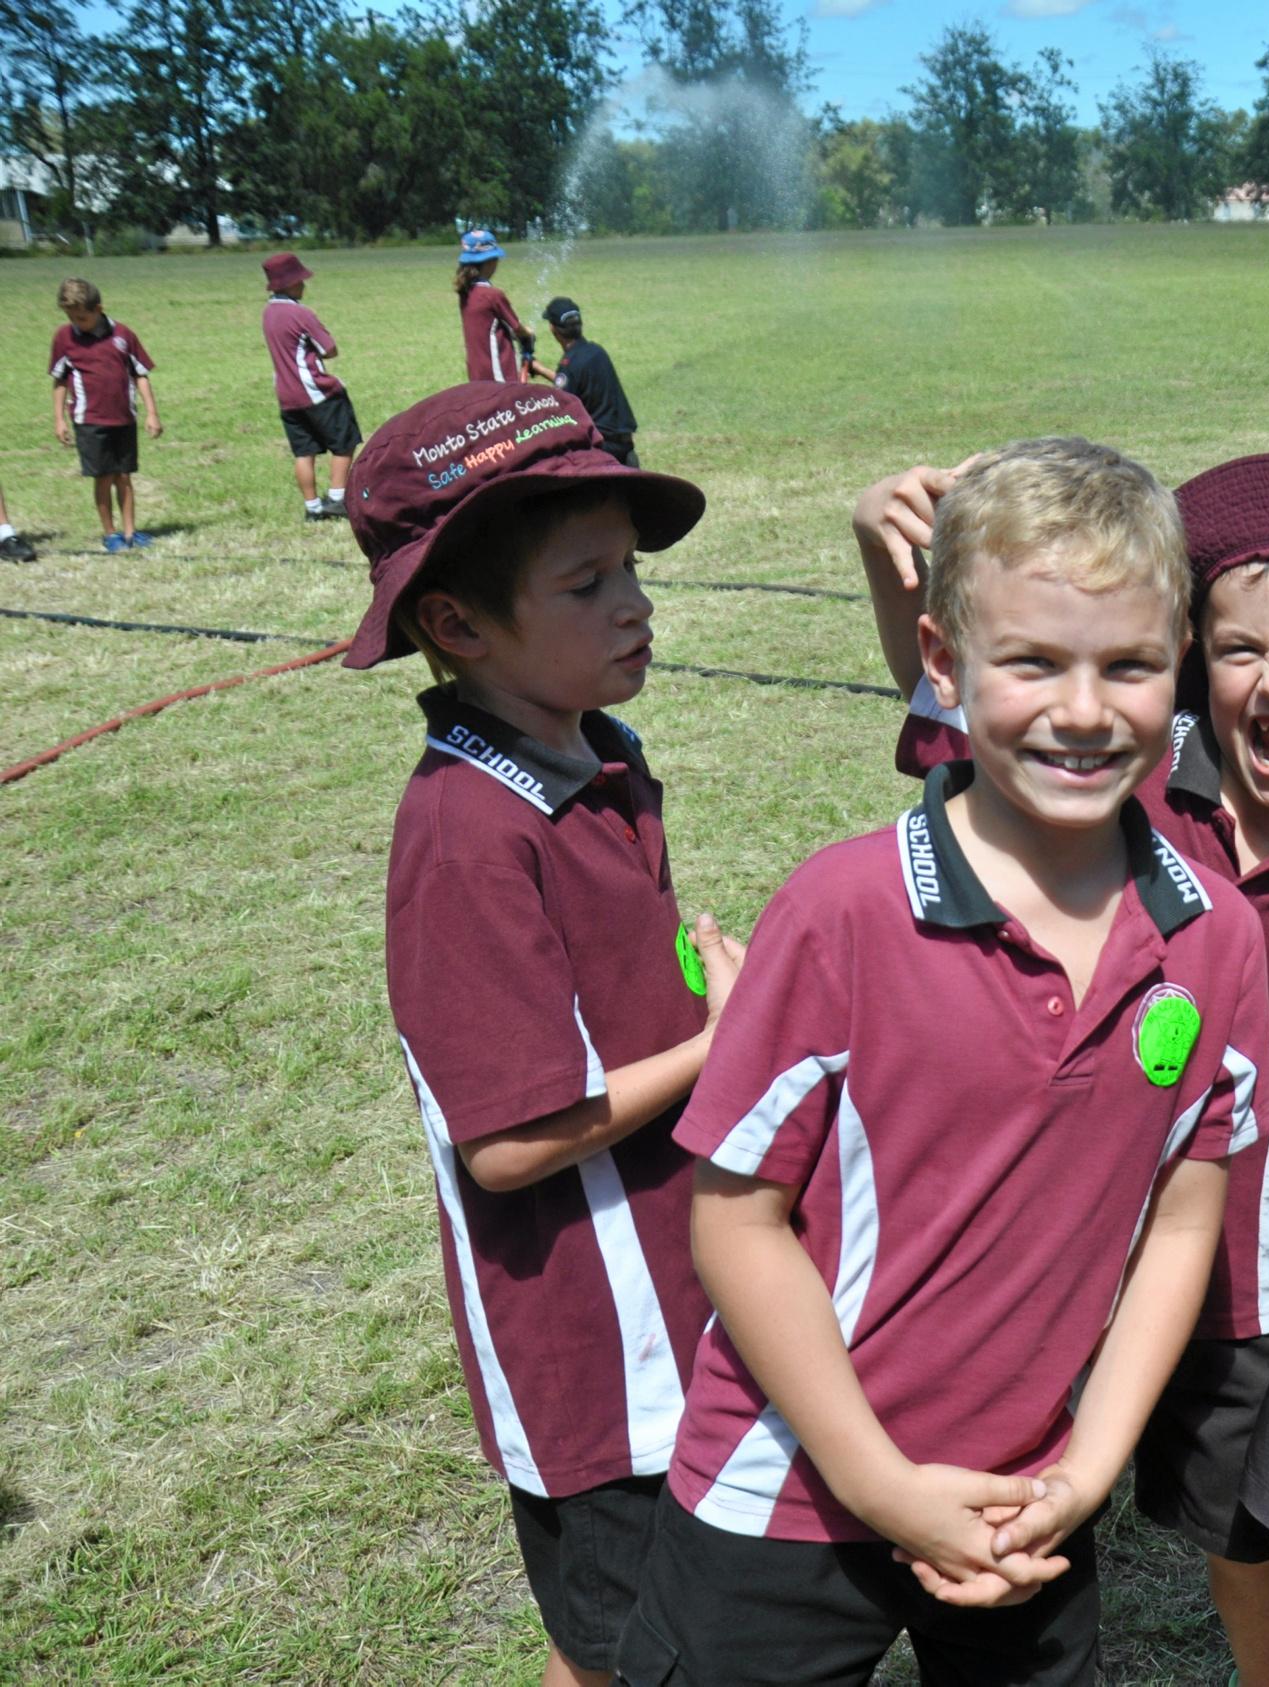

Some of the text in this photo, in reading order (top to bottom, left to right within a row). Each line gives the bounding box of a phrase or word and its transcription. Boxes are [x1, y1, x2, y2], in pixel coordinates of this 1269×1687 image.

[412, 395, 560, 467] Monto State School
[428, 413, 578, 490] Safe Happy Learning
[446, 725, 545, 800] SCHOOL
[908, 813, 941, 907] SCHOOL
[1152, 838, 1200, 904] MON
